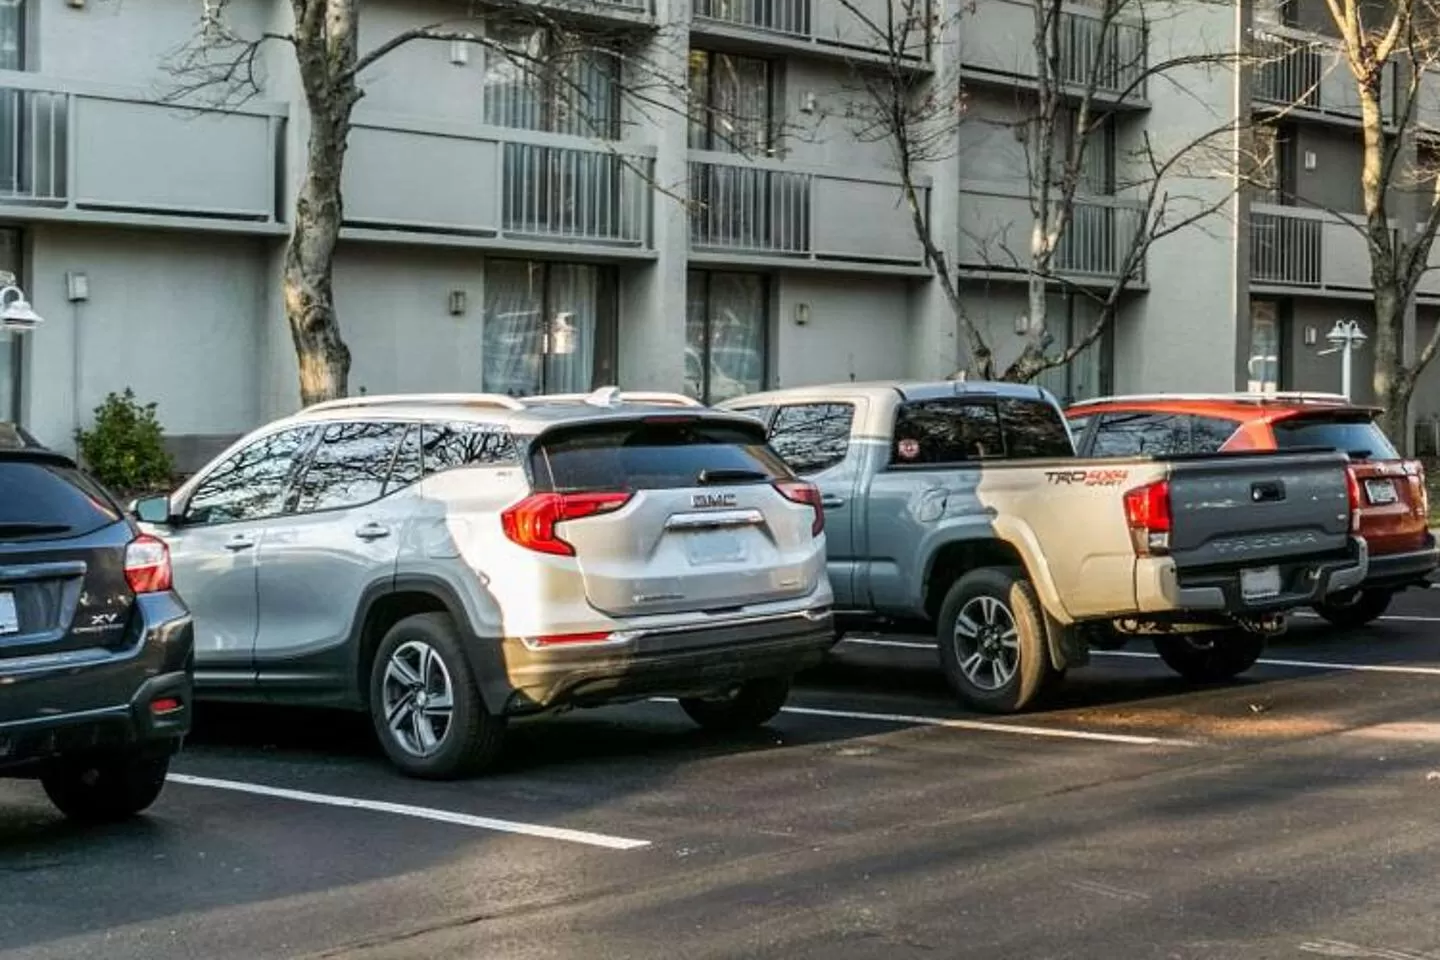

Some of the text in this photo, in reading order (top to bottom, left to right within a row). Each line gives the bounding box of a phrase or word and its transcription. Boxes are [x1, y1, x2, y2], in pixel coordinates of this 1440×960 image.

[1044, 471, 1087, 485] TRD
[691, 494, 738, 508] GMC
[1212, 532, 1318, 554] TACOMA
[91, 613, 117, 624] XV
